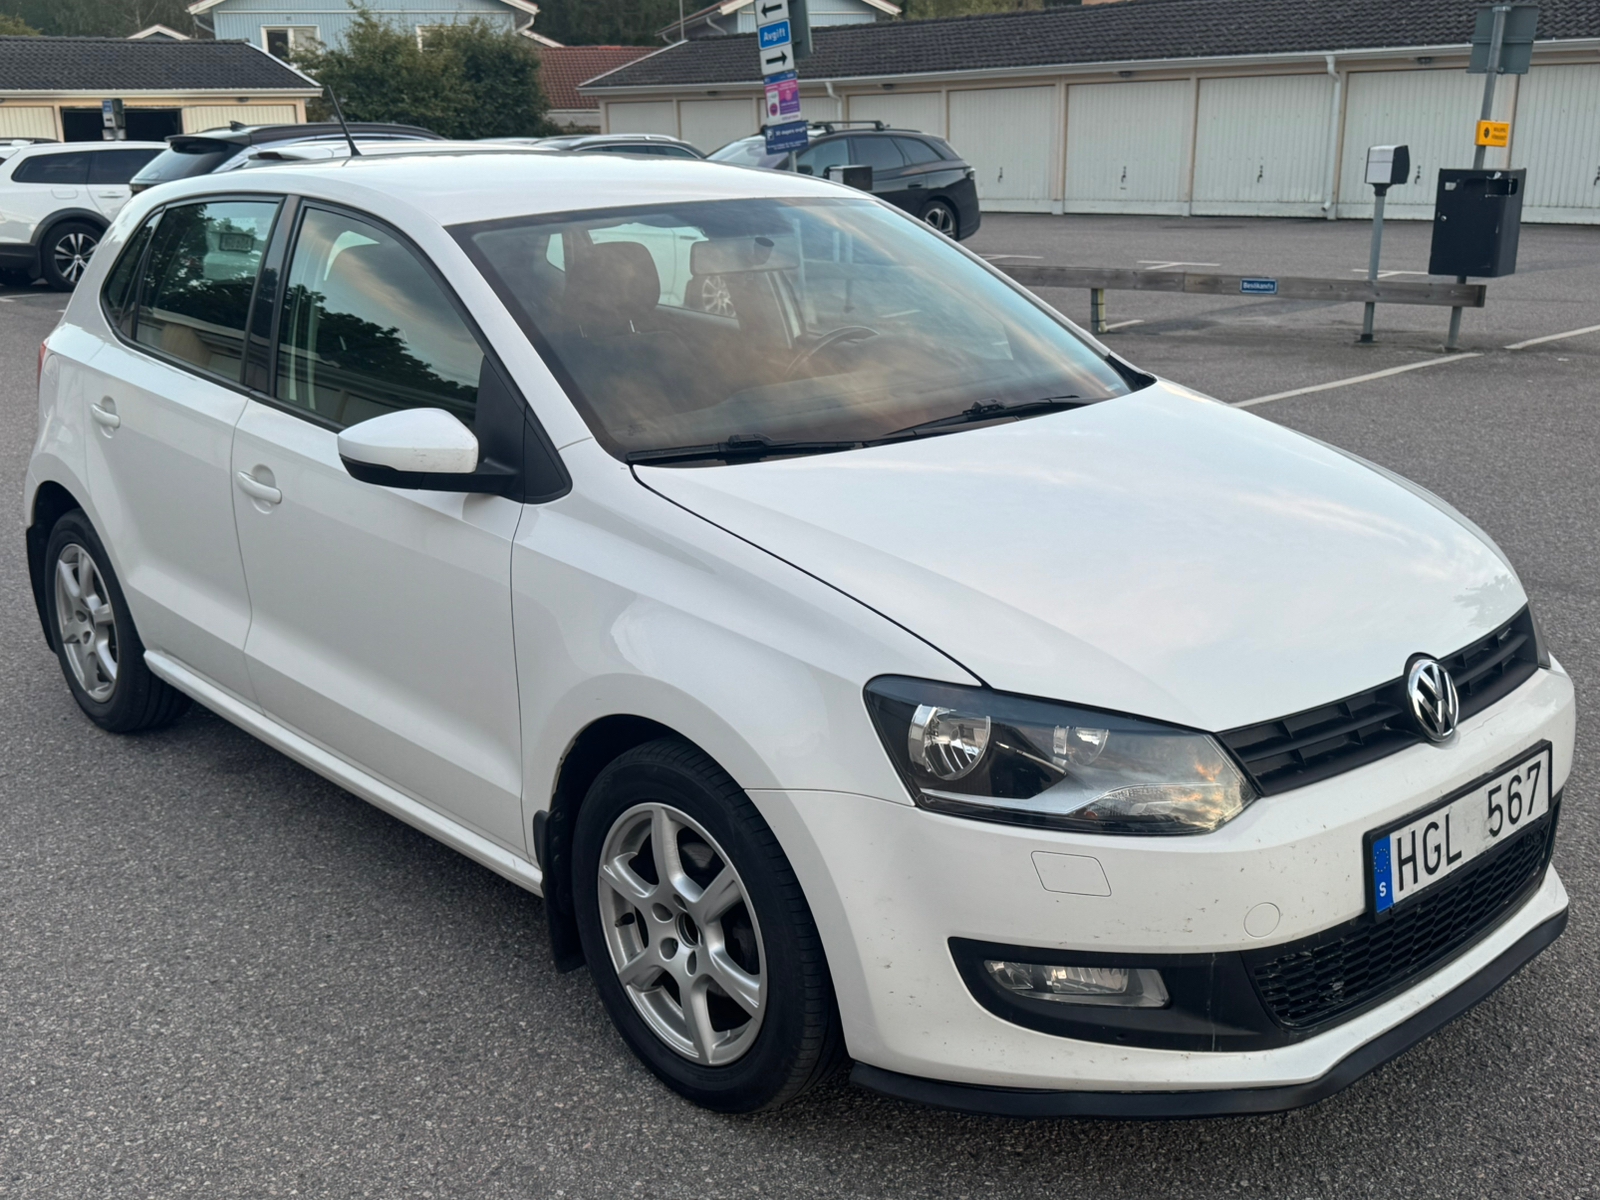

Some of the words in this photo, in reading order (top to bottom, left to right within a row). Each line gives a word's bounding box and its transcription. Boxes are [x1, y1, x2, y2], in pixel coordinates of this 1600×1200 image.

[763, 27, 786, 42] Avgift
[1408, 659, 1460, 742] VW
[1397, 813, 1463, 892] HGL
[1487, 760, 1541, 838] 567
[1379, 881, 1387, 897] S
